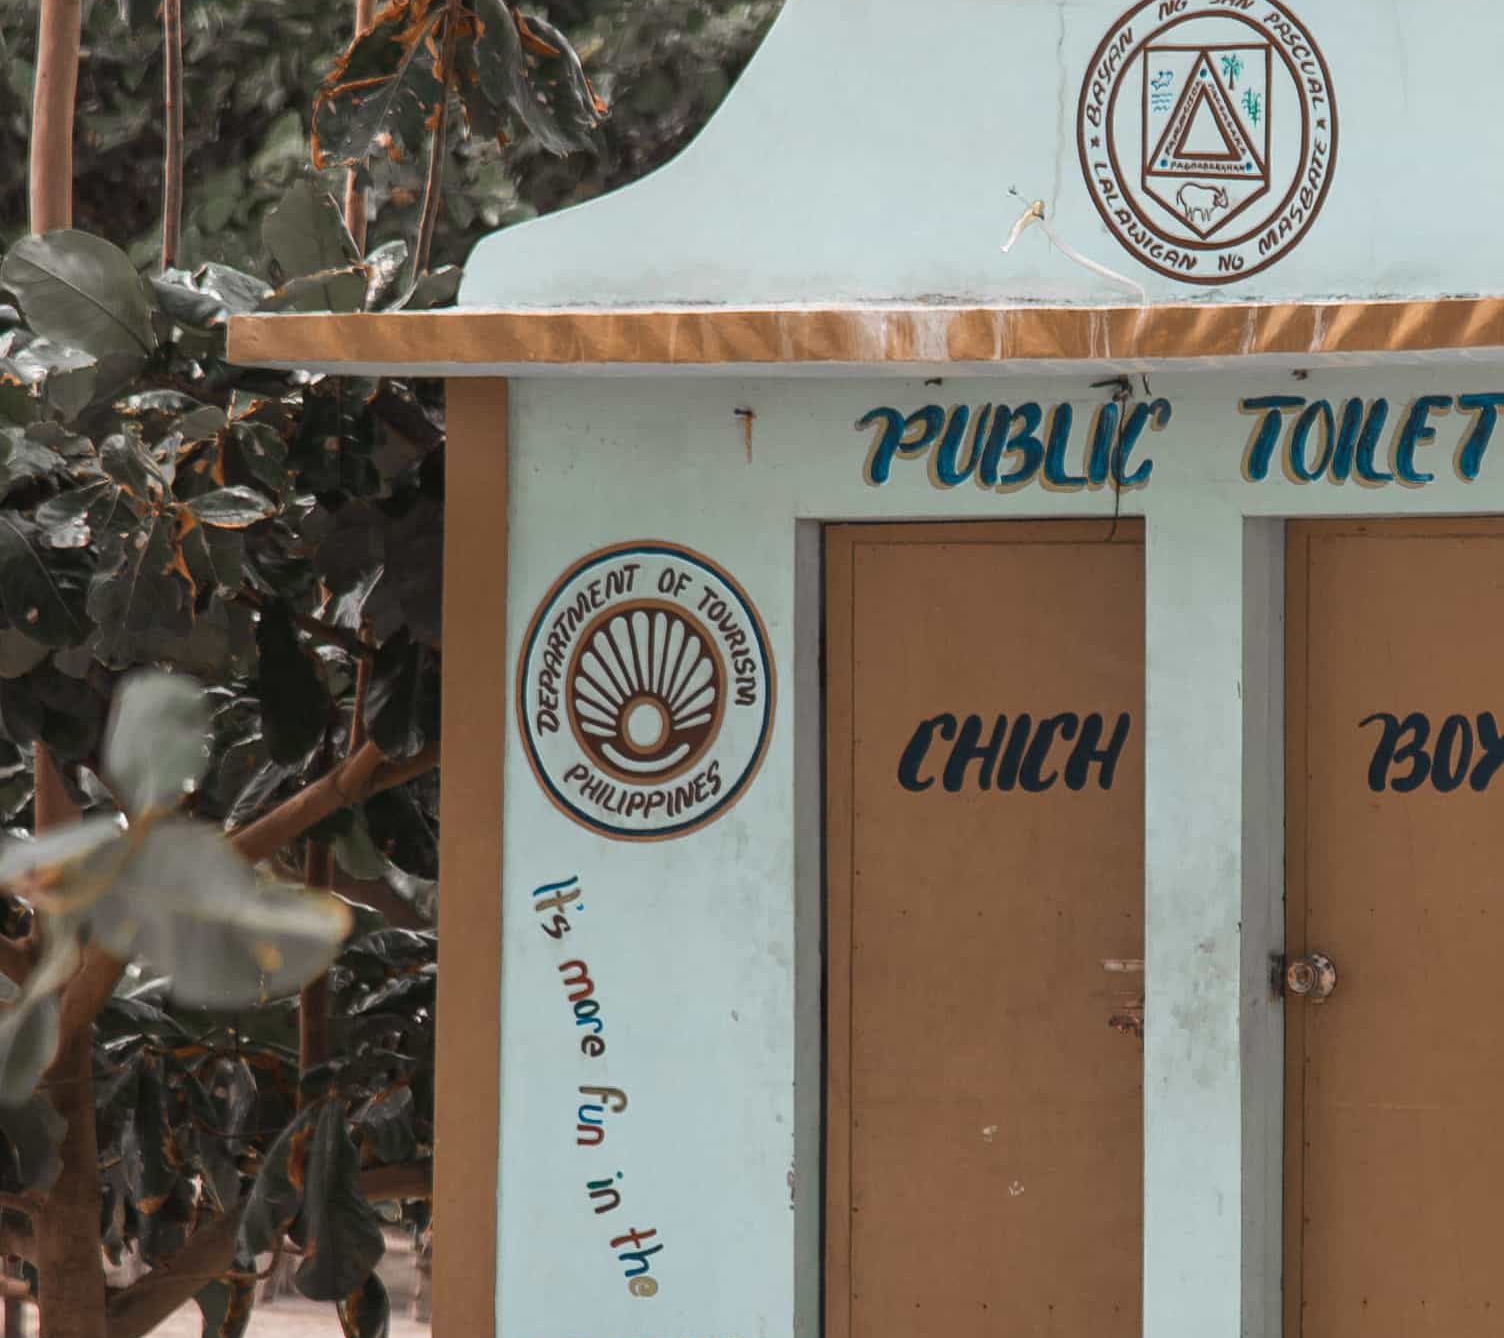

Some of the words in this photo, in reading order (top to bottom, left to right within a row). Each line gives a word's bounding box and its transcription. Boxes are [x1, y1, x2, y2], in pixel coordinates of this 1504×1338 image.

[1086, 27, 1135, 128] BAYAN
[1263, 12, 1326, 110] PASCUAL
[1094, 162, 1198, 270] LALAWIGAN
[1258, 139, 1328, 255] MASBATE
[855, 397, 1172, 492] PUBLIC
[536, 563, 641, 737] DEPARTMENT
[658, 567, 693, 598] OF
[697, 585, 757, 707] TOURISM
[563, 759, 722, 819] PHILIPPINES
[896, 712, 1131, 793] CHICH
[533, 875, 585, 940] It's
[558, 960, 606, 1058] more
[575, 1084, 628, 1146] fun
[586, 1170, 625, 1214] in
[609, 1227, 664, 1298] the
